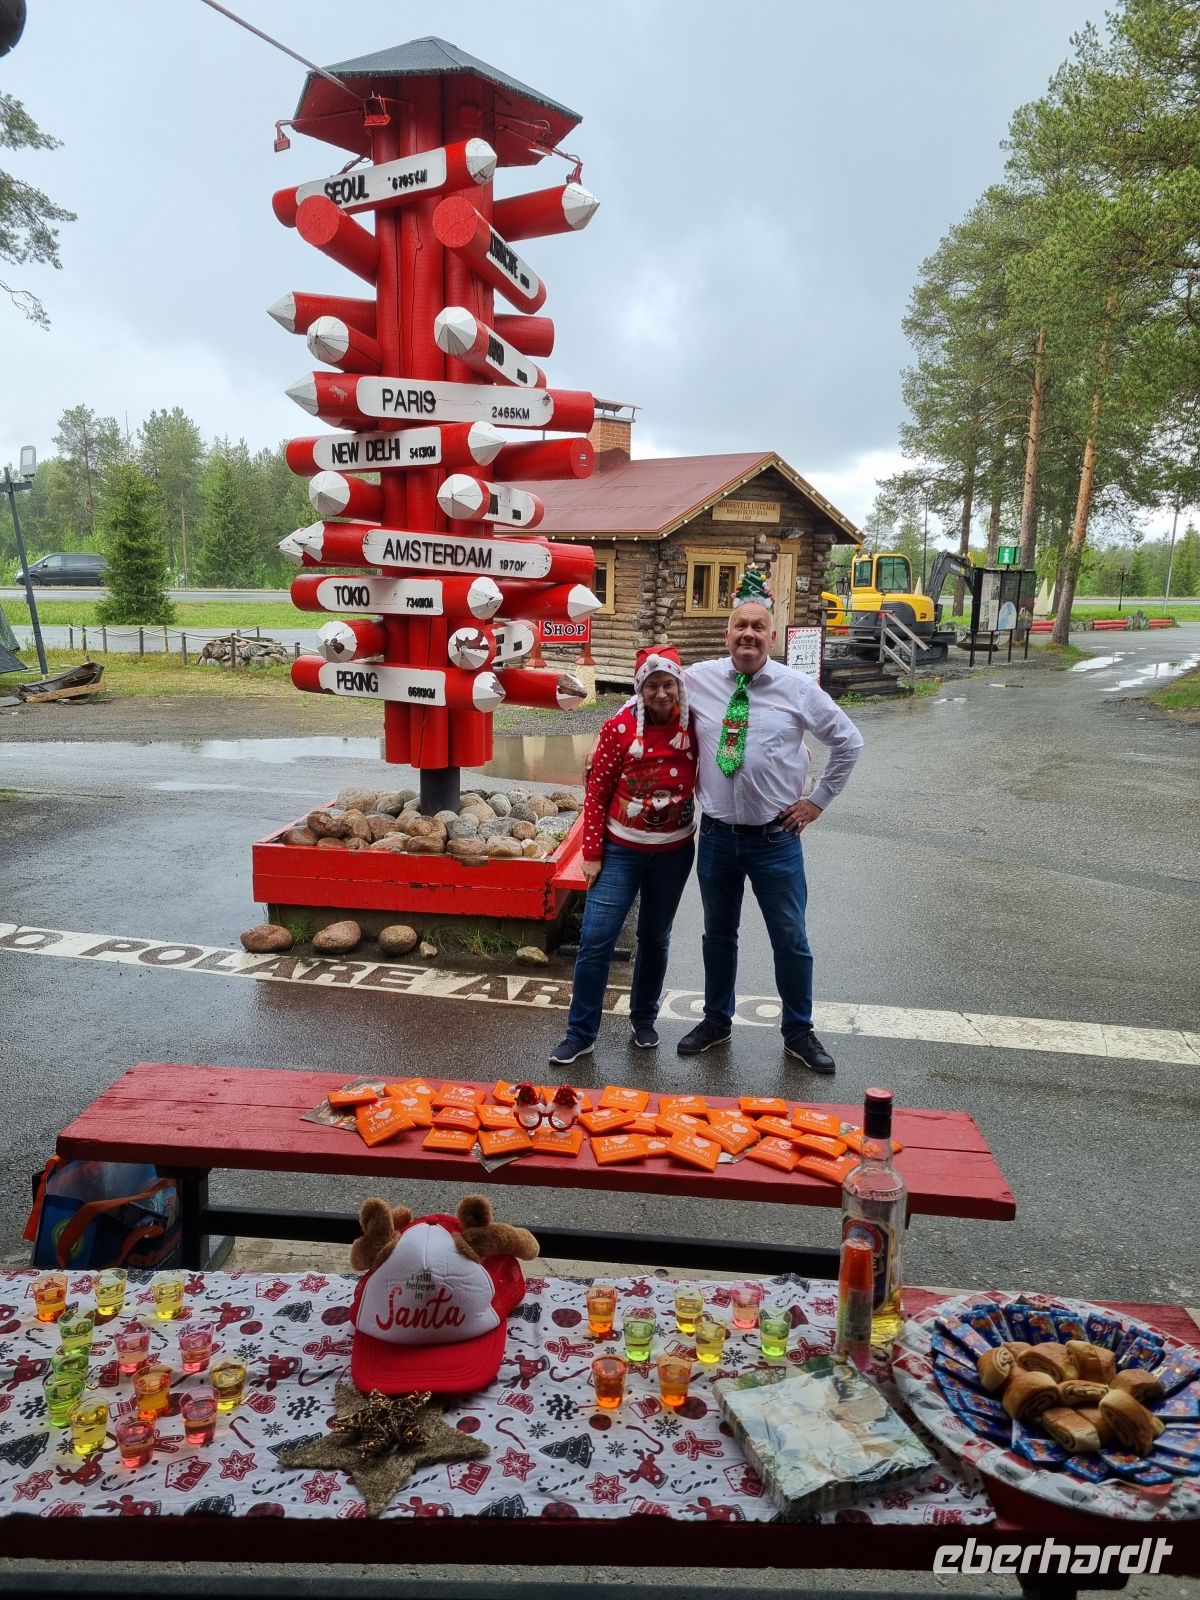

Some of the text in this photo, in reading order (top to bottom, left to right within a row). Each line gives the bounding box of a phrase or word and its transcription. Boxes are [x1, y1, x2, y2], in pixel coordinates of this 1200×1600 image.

[324, 175, 369, 205] SEOUL
[382, 388, 530, 420] PARIS 2465KM
[332, 441, 359, 464] NEW
[365, 438, 400, 462] DELHI
[751, 502, 777, 511] COTTAGE
[382, 538, 492, 569] AMSTERDAM
[333, 585, 370, 607] TOKIO
[544, 621, 586, 636] SHOP
[336, 670, 379, 693] PEKING
[80, 938, 428, 991] POLARE
[448, 974, 782, 1026] ARTCO
[443, 1092, 475, 1105] Reisen
[434, 1131, 468, 1141] Reisen
[713, 1124, 742, 1143] Reisen
[600, 1143, 635, 1153] Reisen
[678, 1140, 710, 1158] Reisen
[760, 1143, 793, 1158] Reisen
[416, 1271, 432, 1281] still
[406, 1280, 436, 1291] believe
[414, 1291, 423, 1300] in
[375, 1286, 466, 1331] Santa
